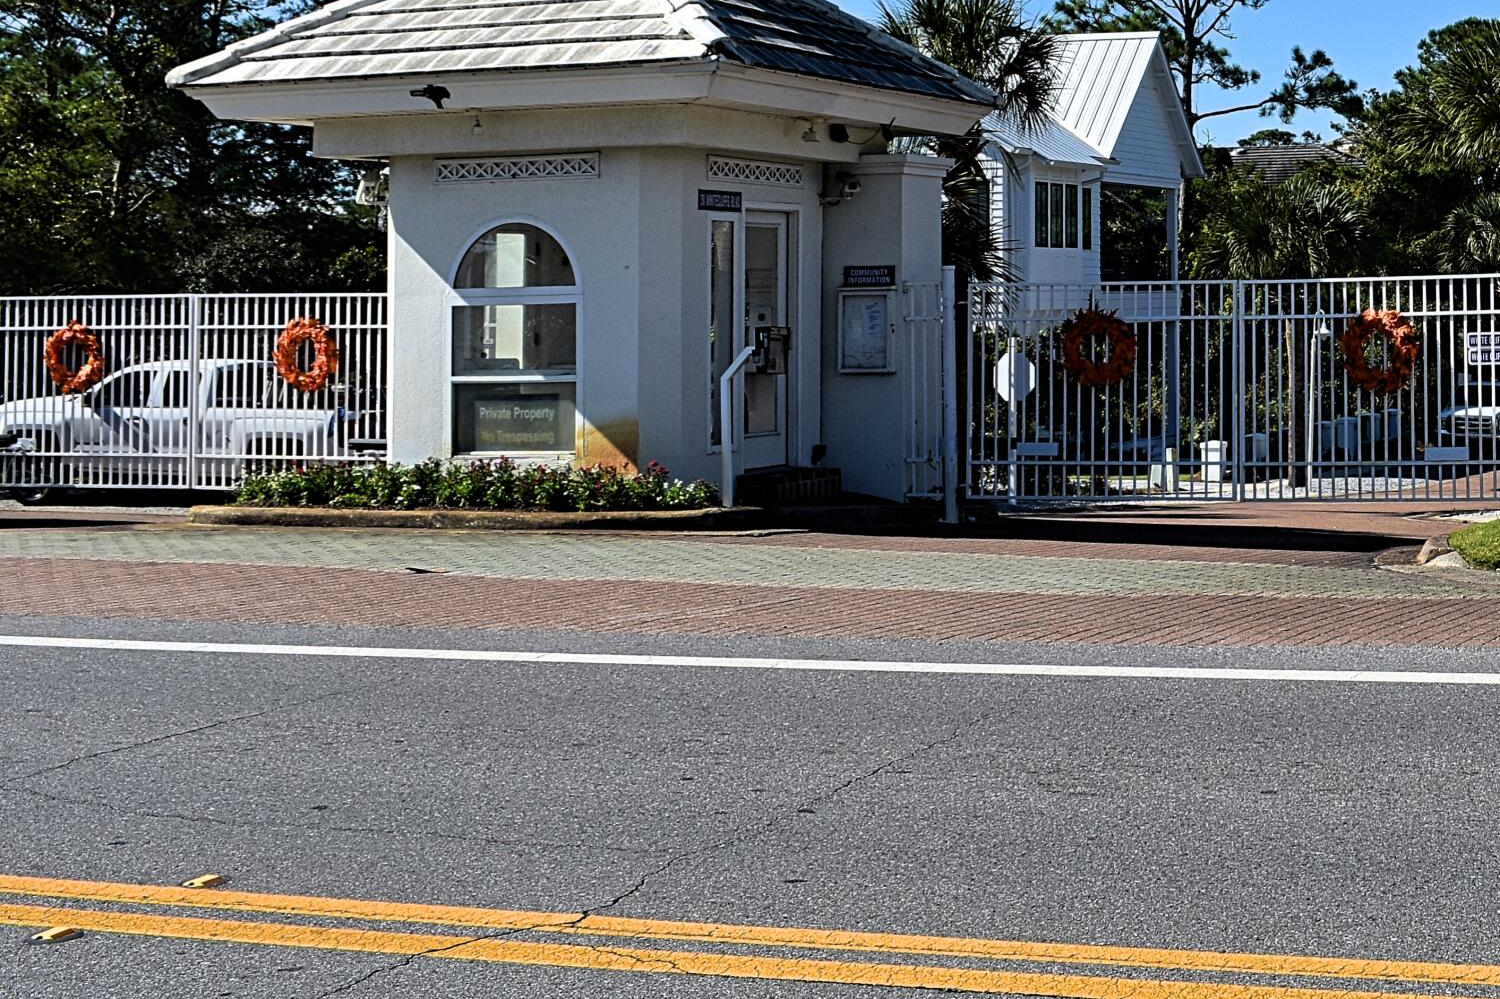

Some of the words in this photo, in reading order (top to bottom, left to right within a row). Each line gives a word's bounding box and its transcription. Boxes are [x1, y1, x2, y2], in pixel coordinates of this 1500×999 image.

[850, 268, 888, 276] COMMUNITY
[848, 276, 891, 284] INFORMATION
[479, 407, 511, 419] Private
[513, 406, 555, 421] Property
[481, 430, 495, 442] No
[496, 431, 554, 445] Trespassing
